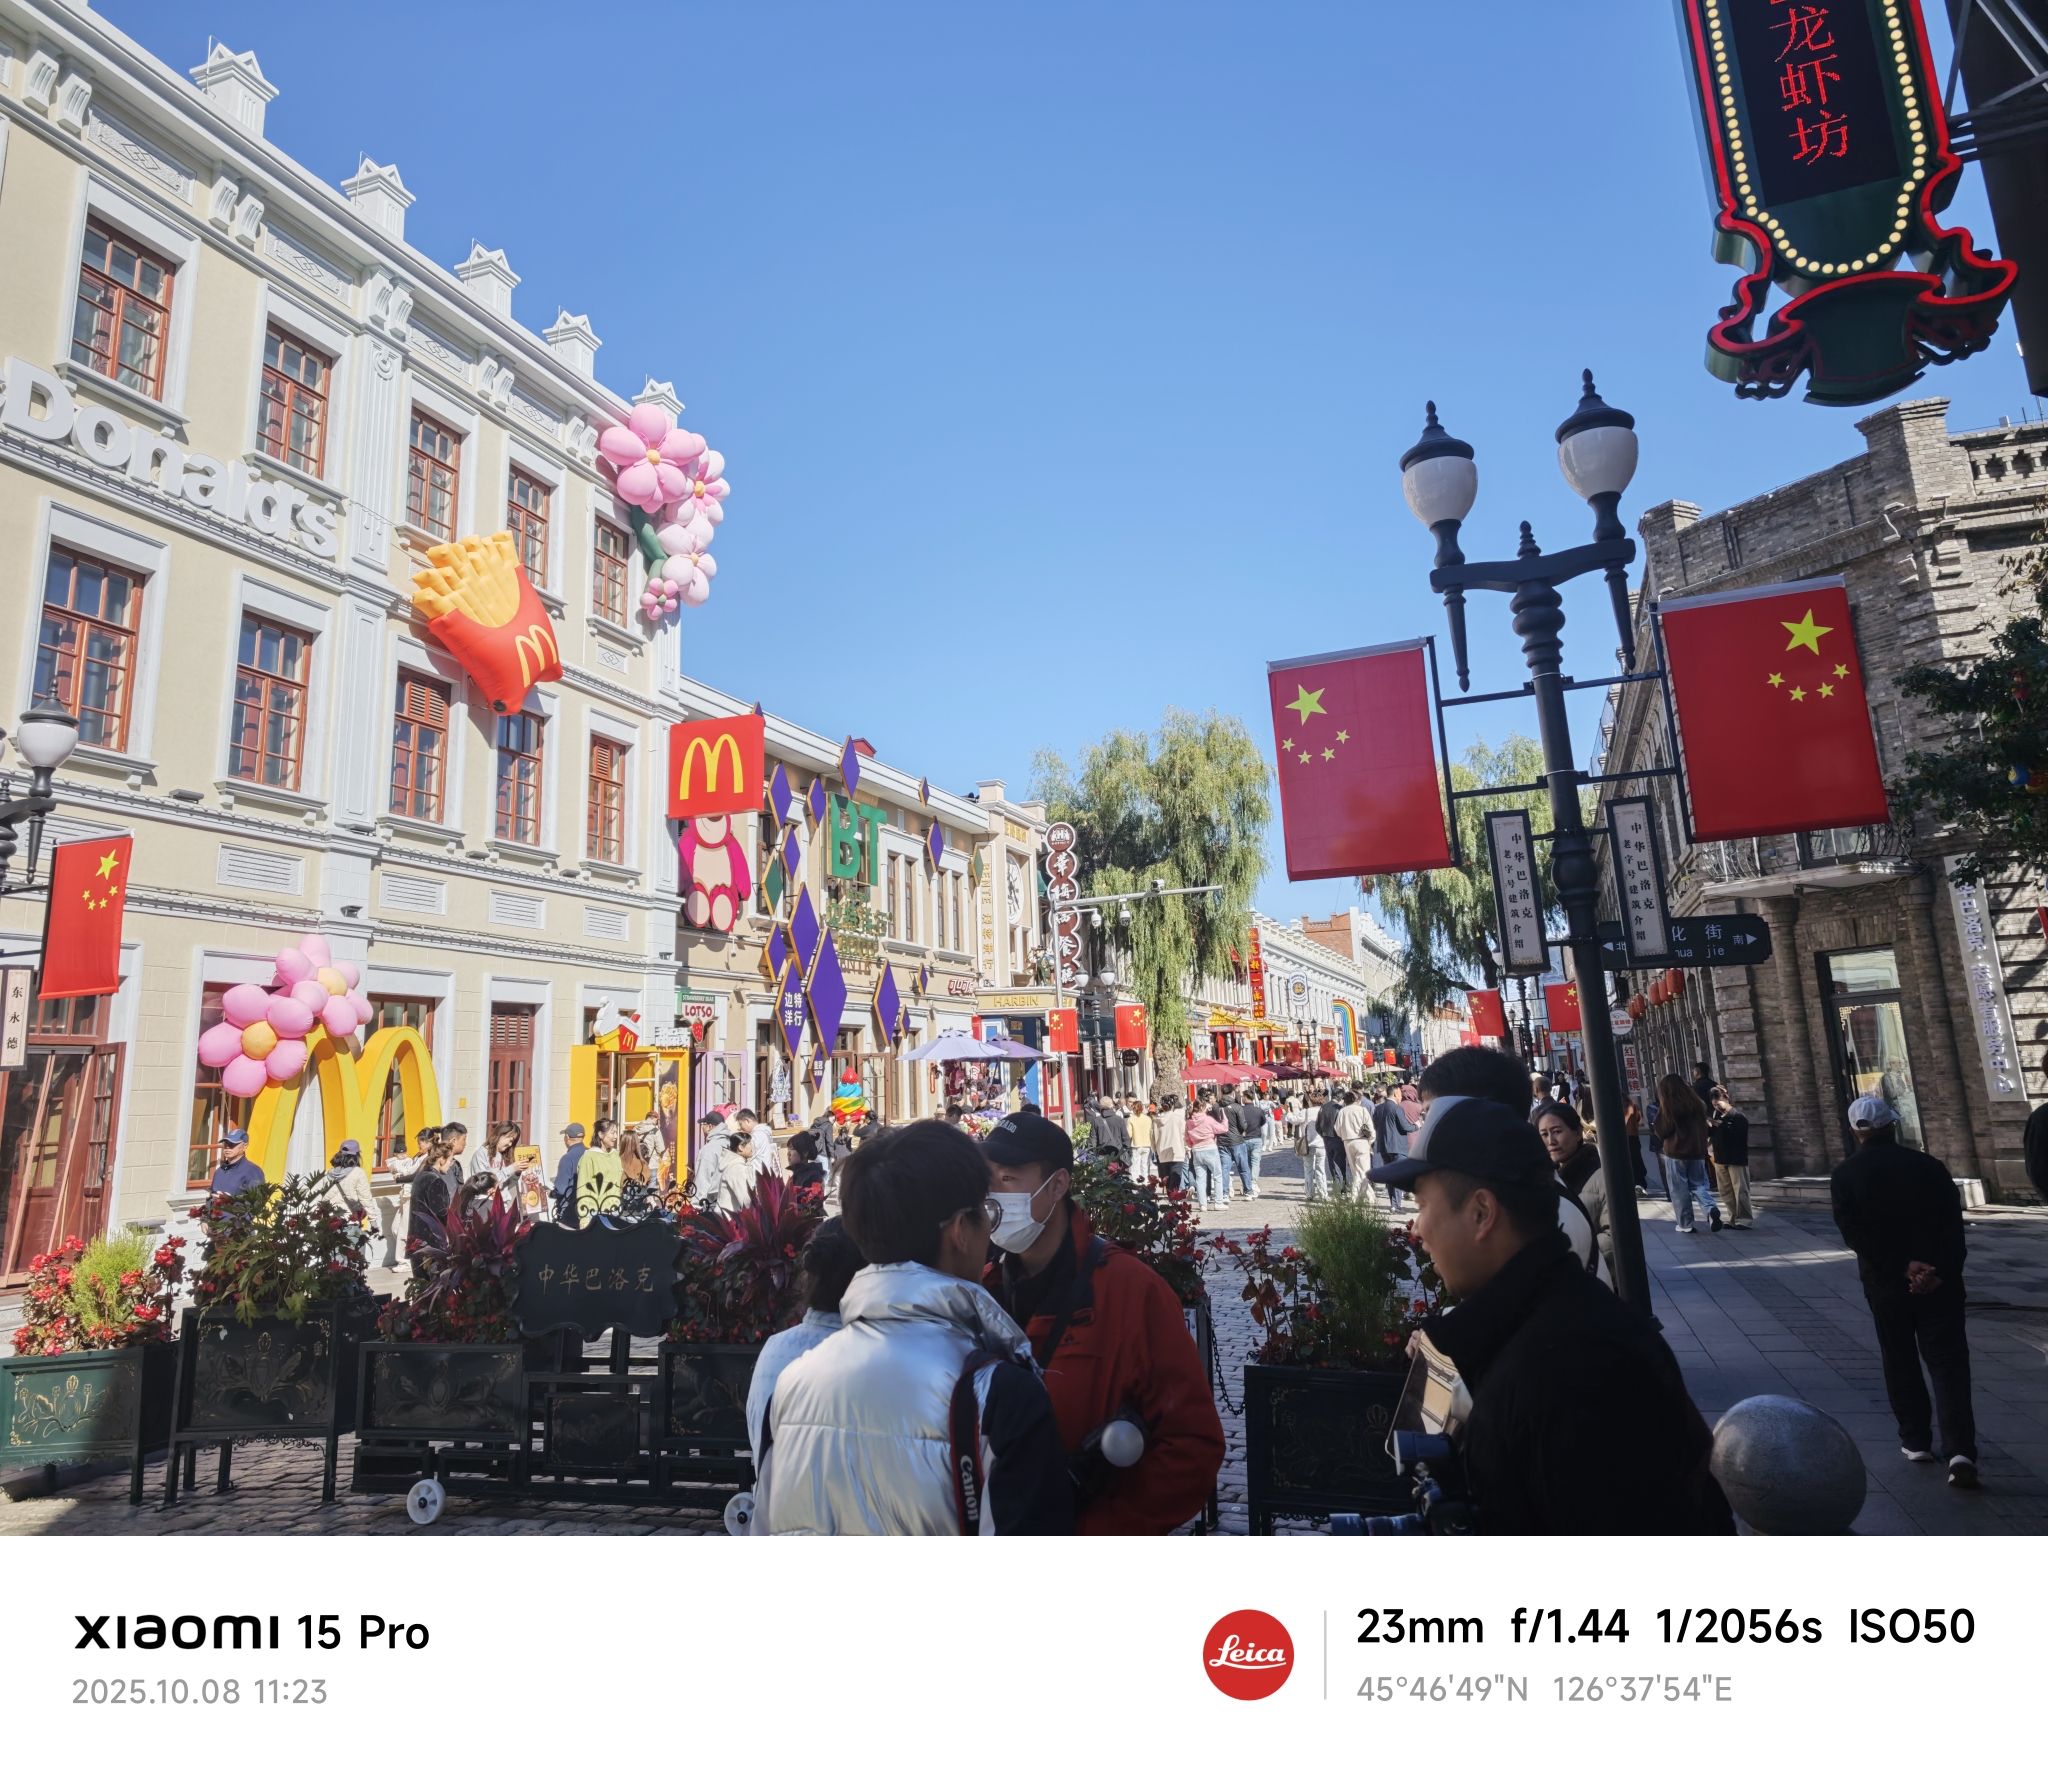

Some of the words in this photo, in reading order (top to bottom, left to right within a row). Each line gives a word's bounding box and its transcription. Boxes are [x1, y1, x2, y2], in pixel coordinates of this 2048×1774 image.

[1768, 0, 1848, 165] 龙虾坊
[0, 356, 338, 557] Donald's
[831, 791, 888, 886] BT
[1631, 822, 1655, 910] 中华巴洛克
[1503, 849, 1525, 949] 老字号建筑介绍
[1511, 833, 1533, 919] 中华巴洛克
[1623, 839, 1646, 941] 老字号建筑介绍
[1706, 946, 1725, 959] jie
[1732, 934, 1744, 945] 南
[7, 986, 24, 1050] 东永德
[685, 1005, 713, 1018] LOTSO
[784, 992, 803, 1009] 边特
[784, 1010, 803, 1027] 洋行
[993, 995, 1039, 1007] HARBIN
[538, 1263, 654, 1295] 中华巴洛克
[960, 1455, 979, 1521] Canon
